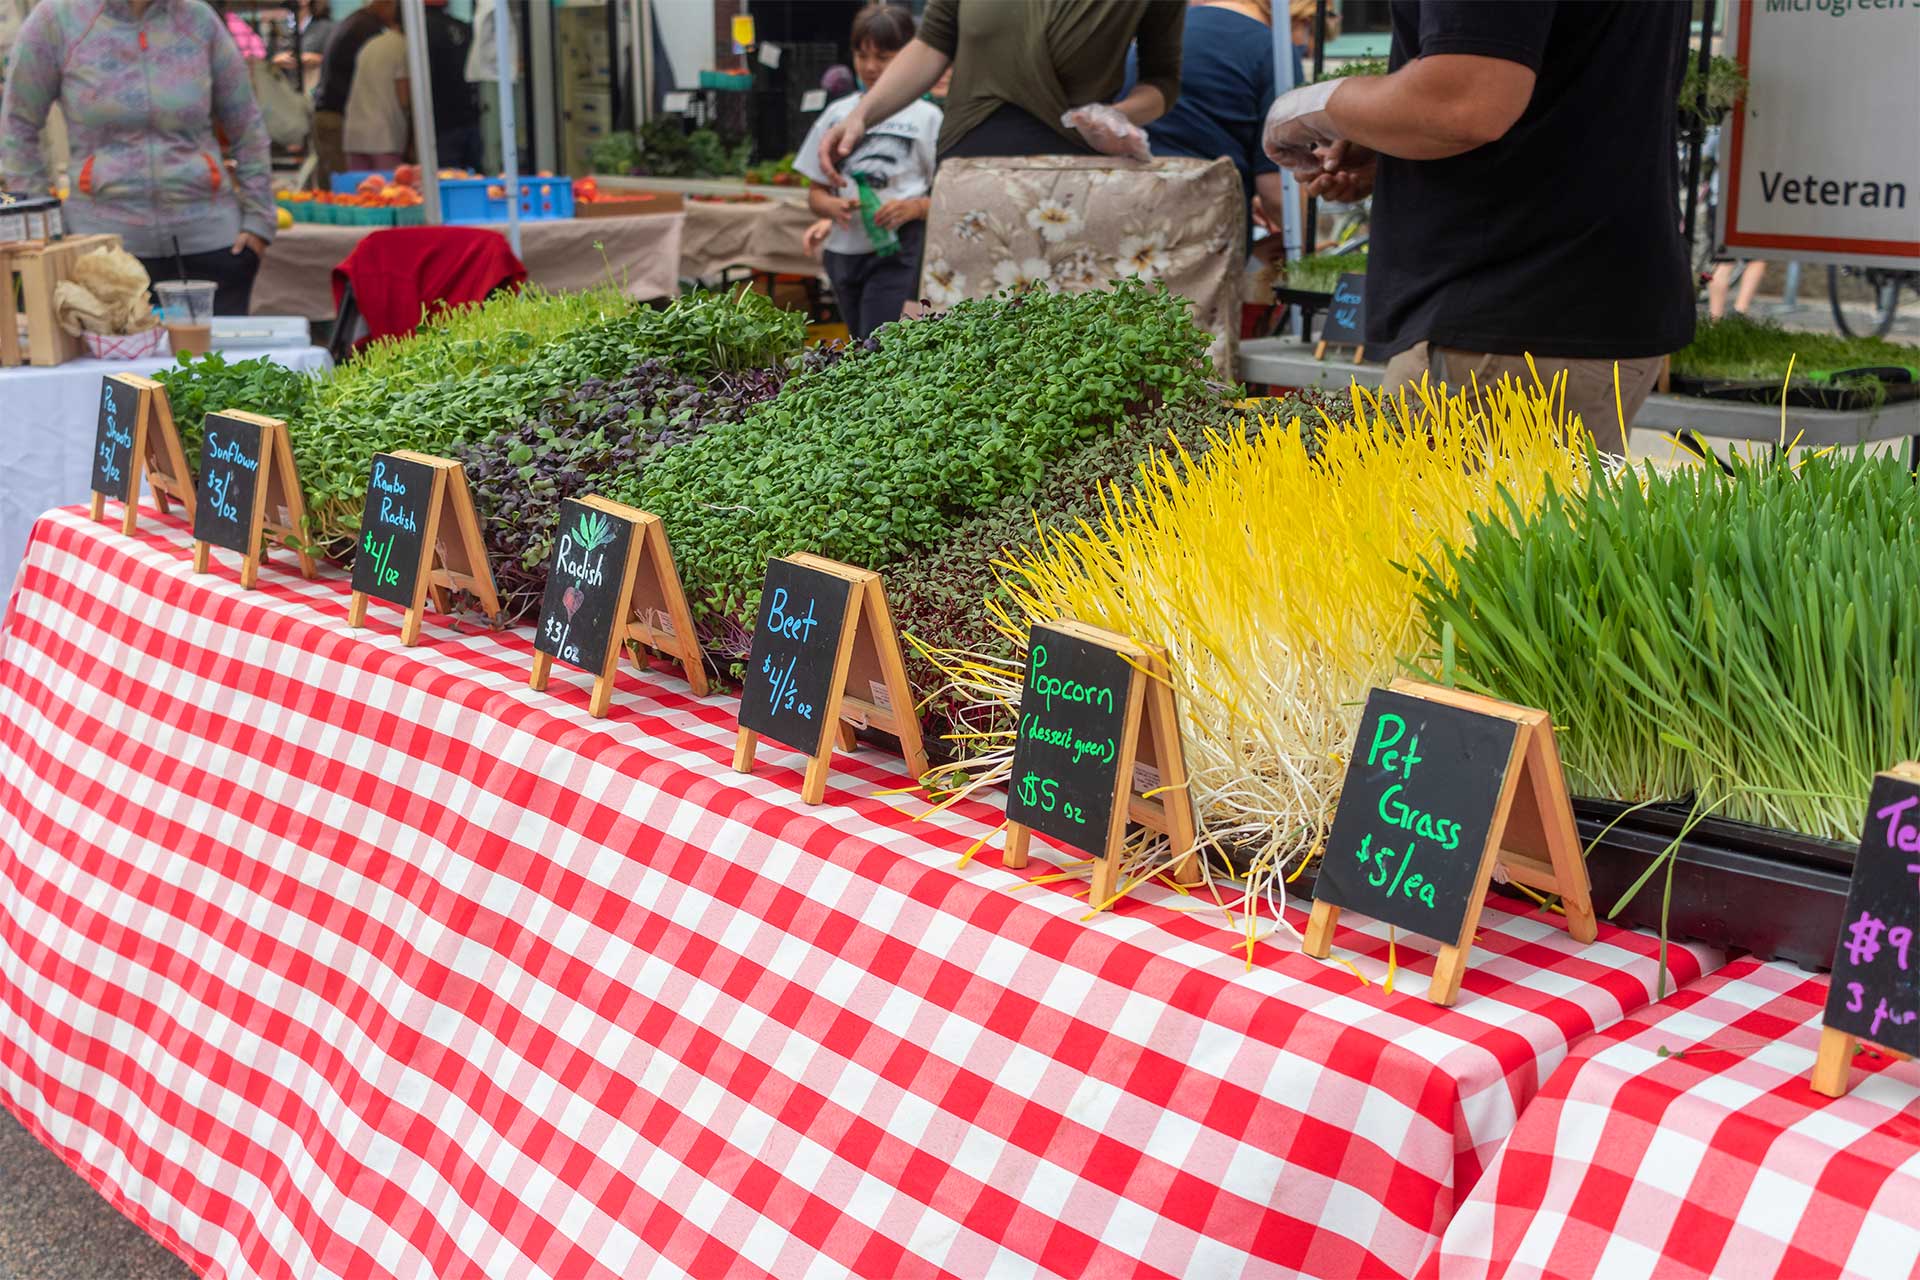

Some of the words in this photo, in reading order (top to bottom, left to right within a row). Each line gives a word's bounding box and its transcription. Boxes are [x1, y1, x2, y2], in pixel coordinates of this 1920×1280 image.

[1760, 171, 1906, 209] Veteran
[104, 385, 117, 415] Pea
[106, 415, 131, 449] Shoots
[209, 432, 258, 472] Sunflower
[100, 440, 121, 482] $3/oz
[373, 461, 406, 496] Rambo
[207, 469, 239, 523] $3/oz
[380, 497, 417, 533] Radish
[363, 530, 400, 586] $4/oz
[556, 534, 603, 587] Radish
[544, 615, 580, 663] $3/oz
[767, 588, 817, 643] Beet
[1031, 645, 1113, 714] Popcorn
[1020, 712, 1073, 749] (dessert
[1072, 737, 1115, 764] green)
[1368, 713, 1422, 779] Pet
[1017, 771, 1059, 812] $5
[1063, 802, 1086, 824] oz
[1378, 784, 1462, 850] Grass
[1876, 795, 1920, 852] Te
[1355, 833, 1436, 909] $5/ea
[1845, 981, 1865, 1013] 3
